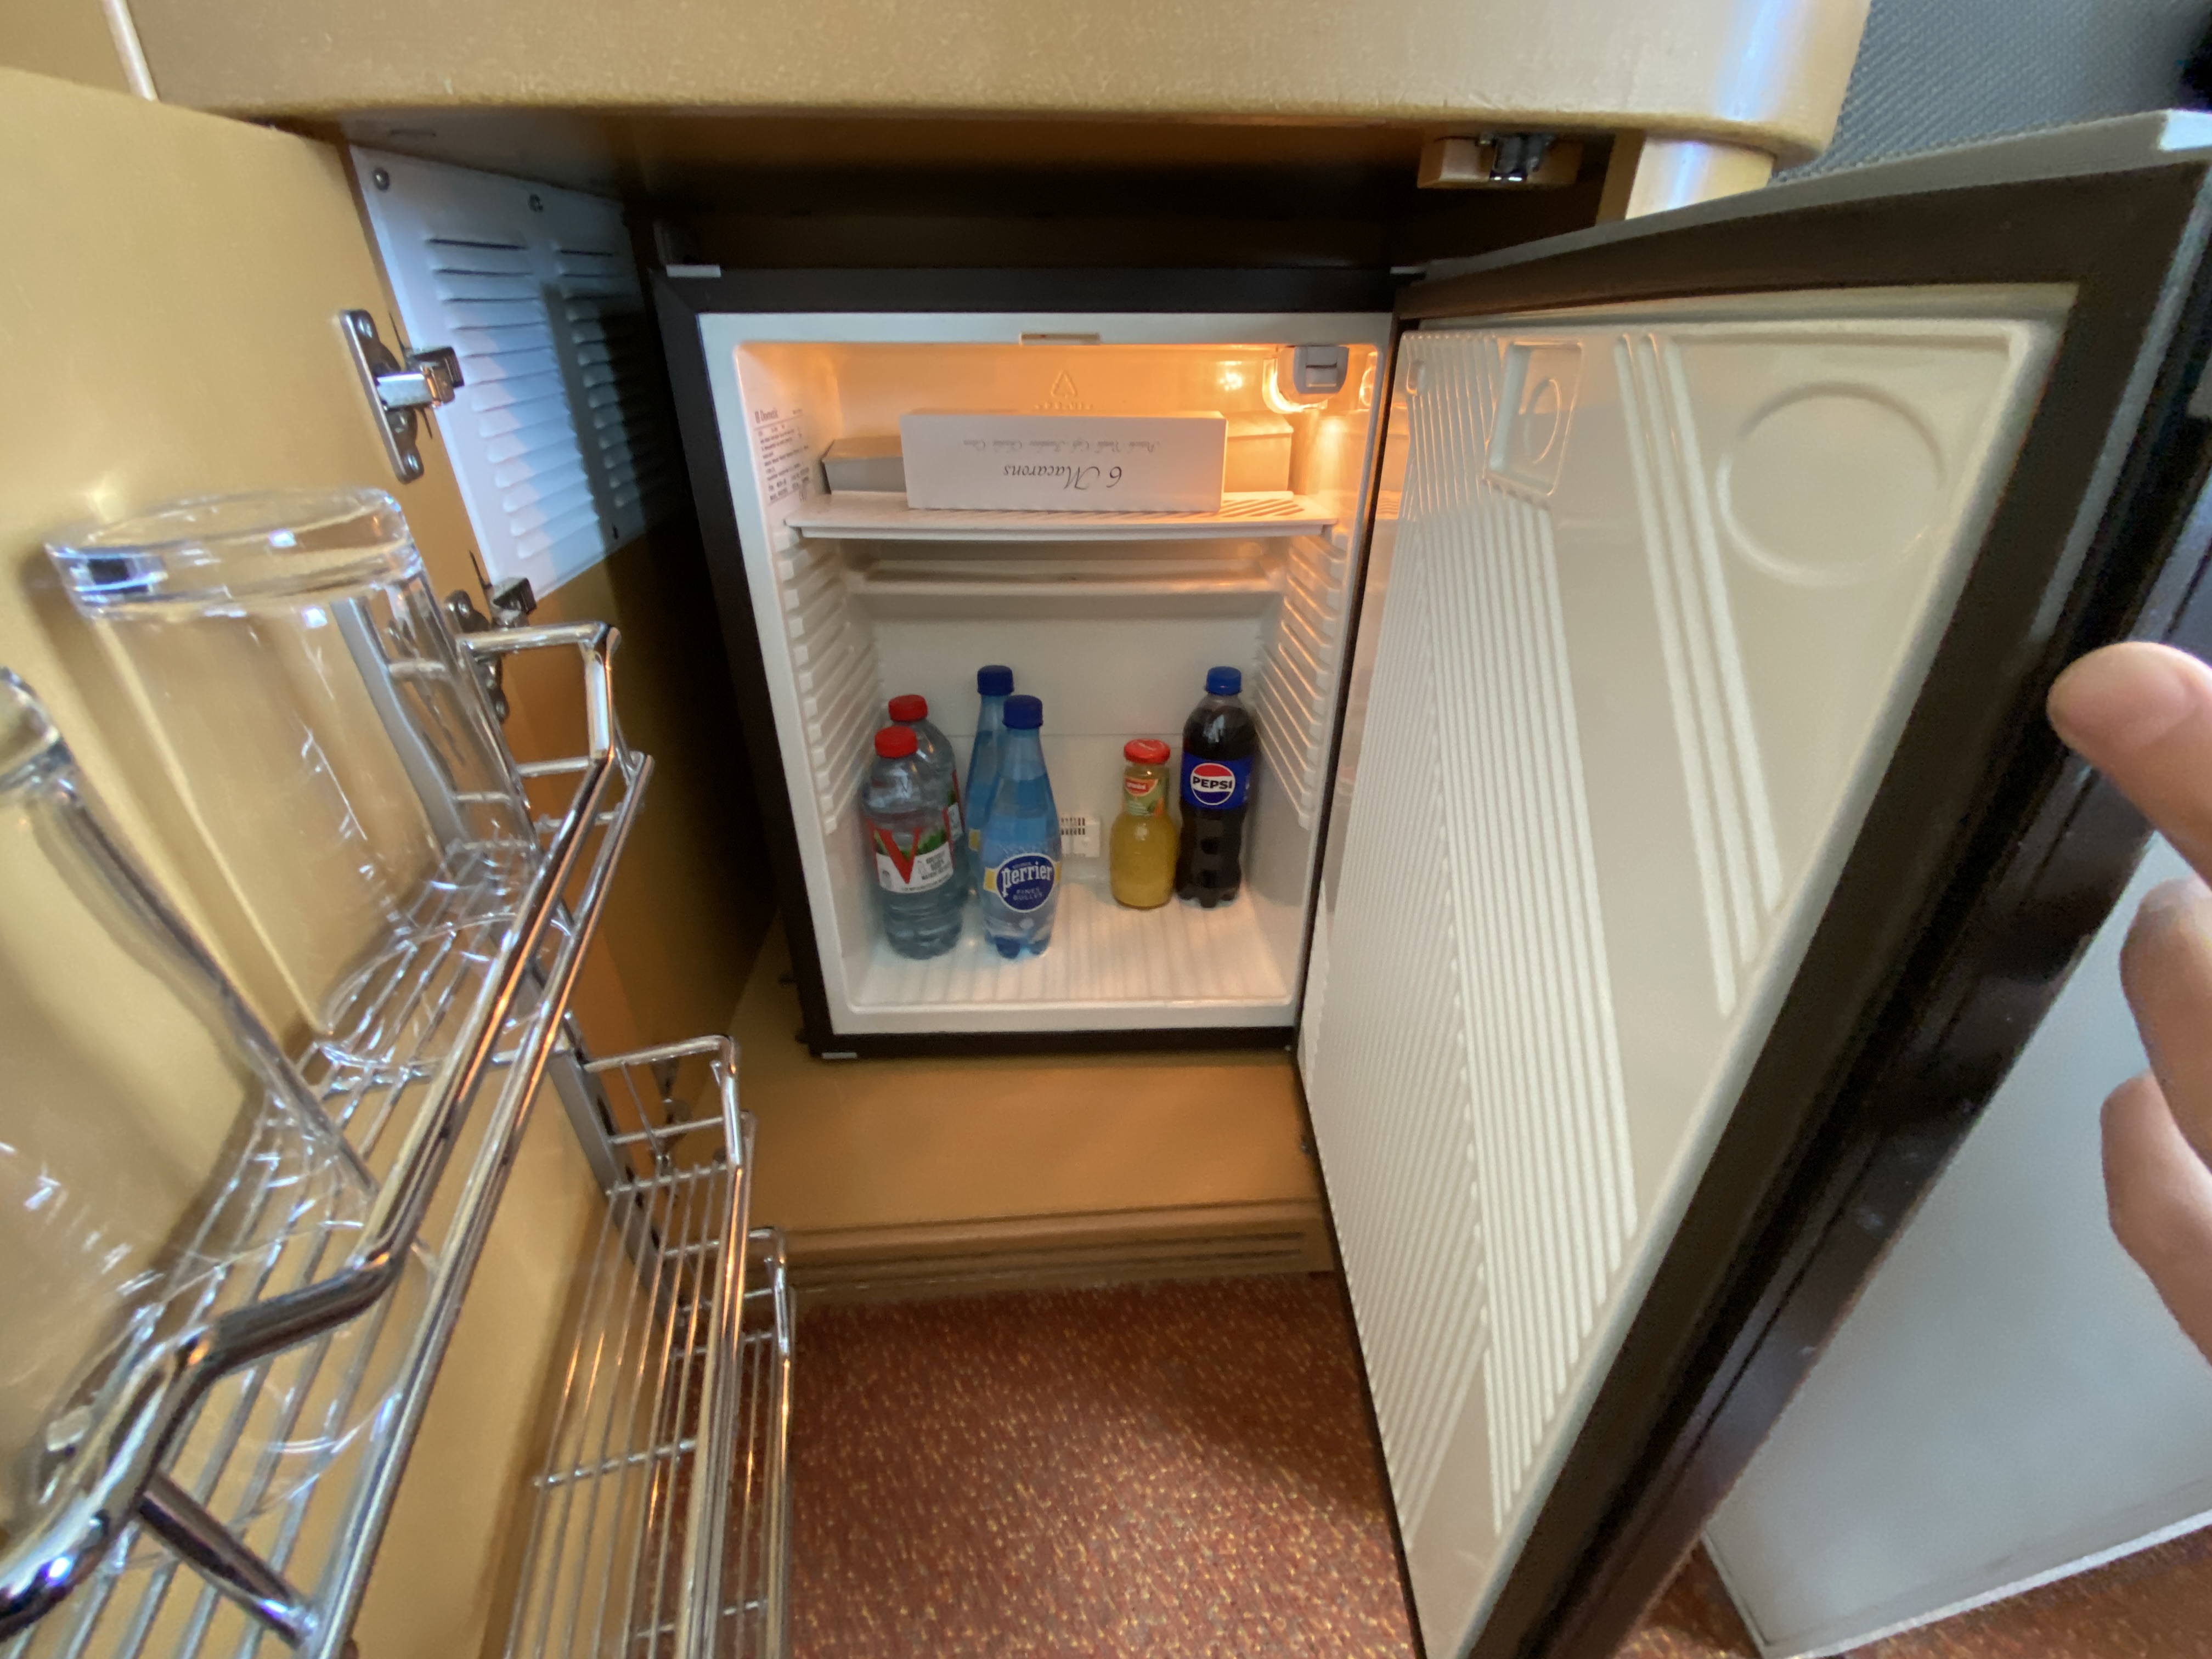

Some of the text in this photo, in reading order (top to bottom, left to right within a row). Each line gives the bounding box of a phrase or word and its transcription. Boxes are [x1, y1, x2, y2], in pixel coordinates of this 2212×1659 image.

[1003, 465, 1122, 490] 6 Macarons
[1192, 776, 1233, 789] PEPSI
